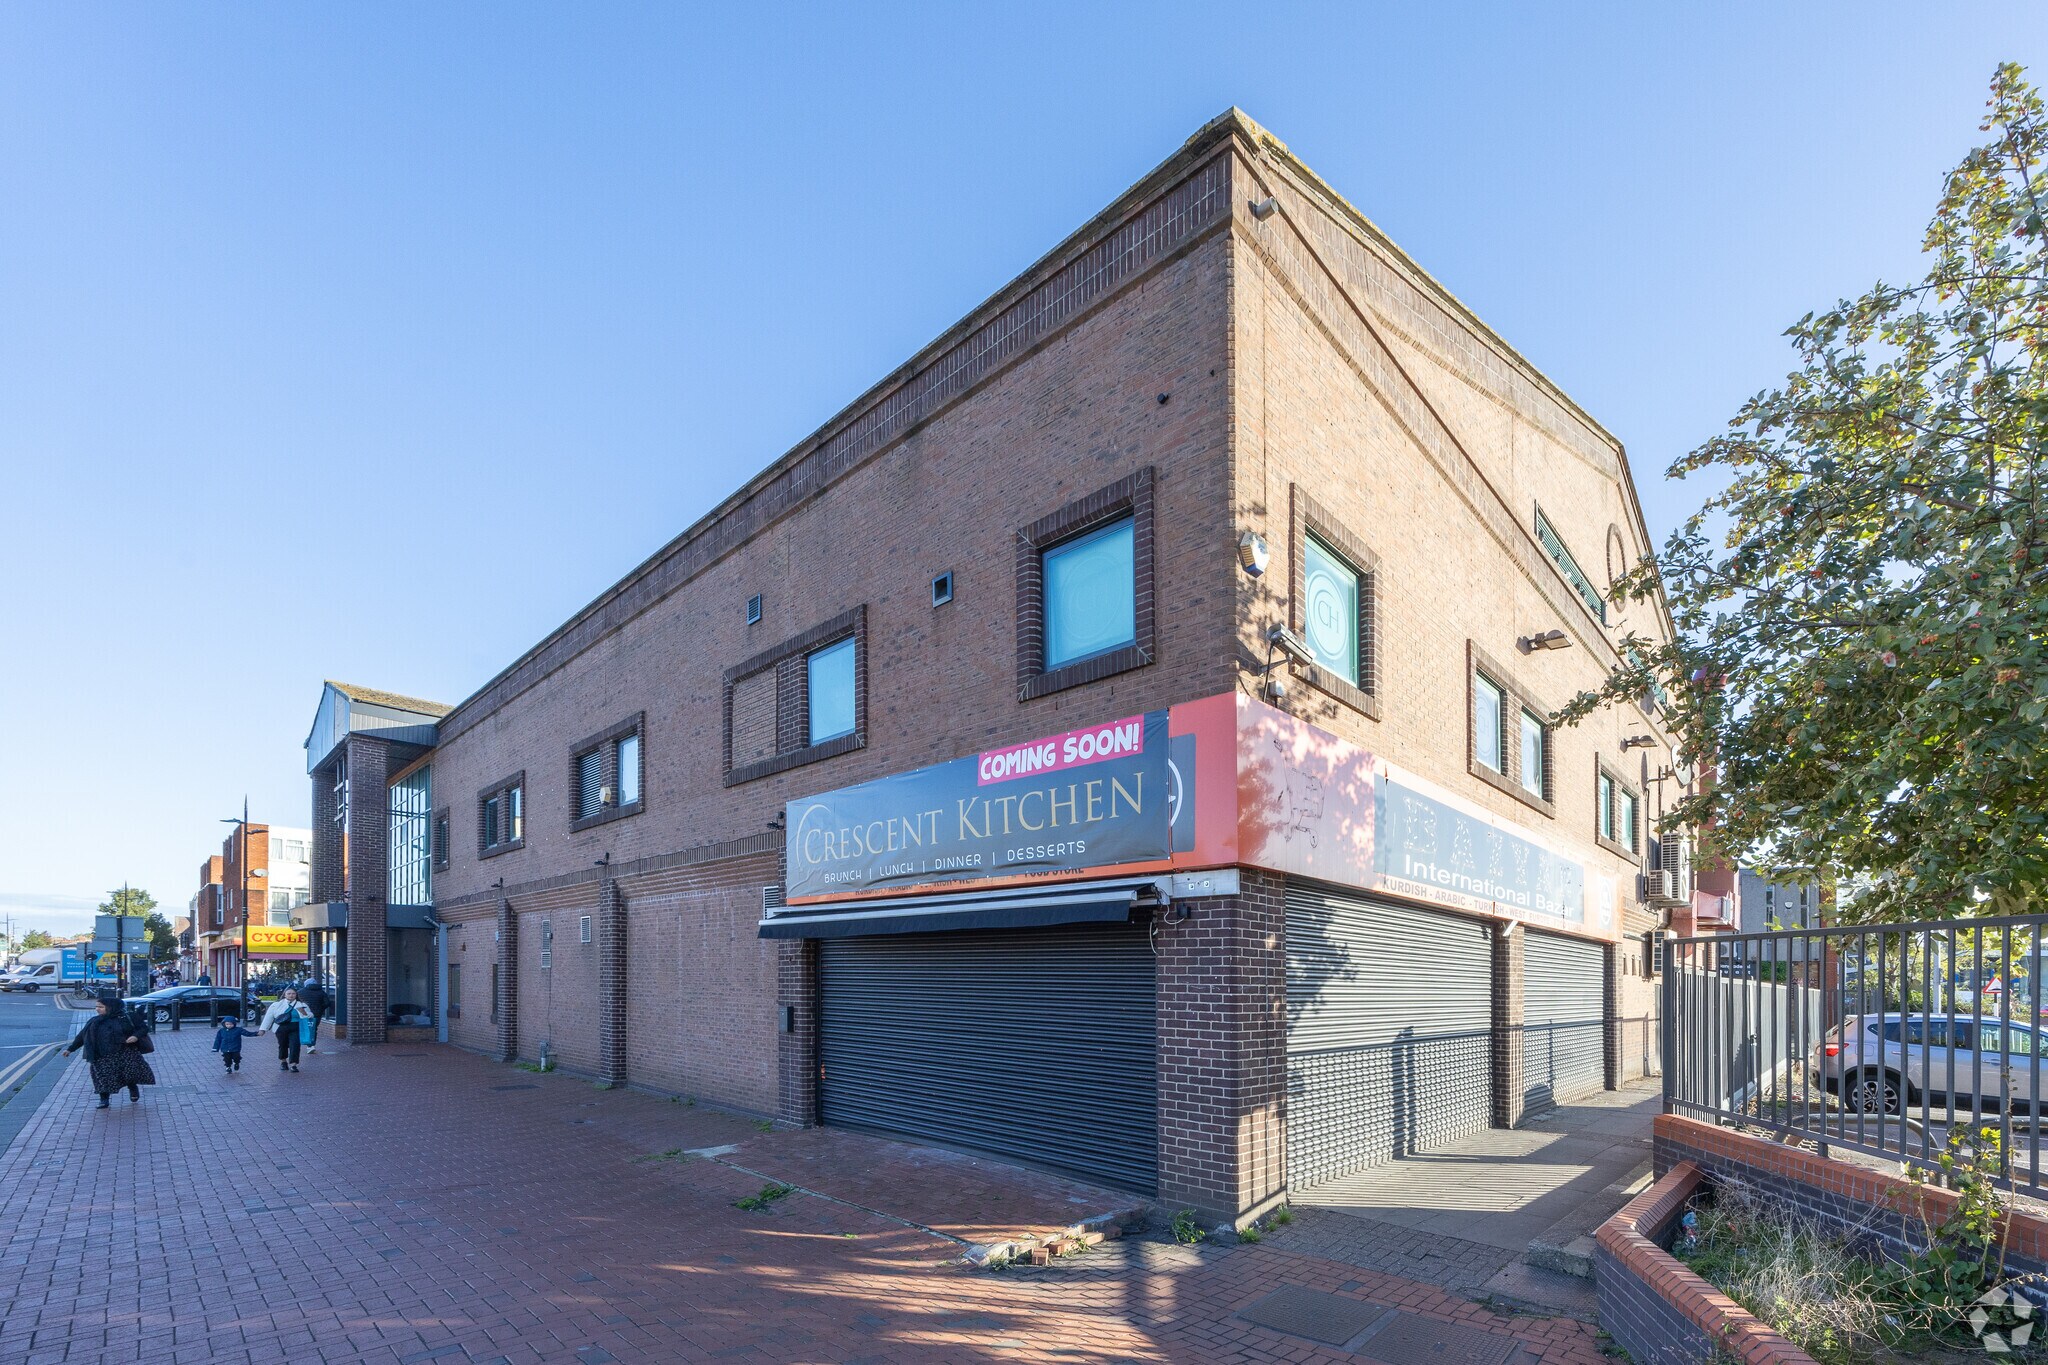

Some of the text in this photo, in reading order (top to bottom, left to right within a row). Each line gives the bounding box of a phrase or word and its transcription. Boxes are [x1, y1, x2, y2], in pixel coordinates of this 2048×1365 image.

[980, 723, 1140, 781] COMING SOON!
[804, 772, 1144, 864] CRESCENT KITCHEN
[824, 840, 1087, 884] BRUNCH LUNCH DINNER DESSERTS
[1405, 854, 1574, 917] International Bazar
[1383, 878, 1427, 897] KURDISH
[1434, 890, 1466, 906] ARABIC
[1474, 899, 1504, 915] TURKSH
[251, 932, 307, 944] CYCLE
